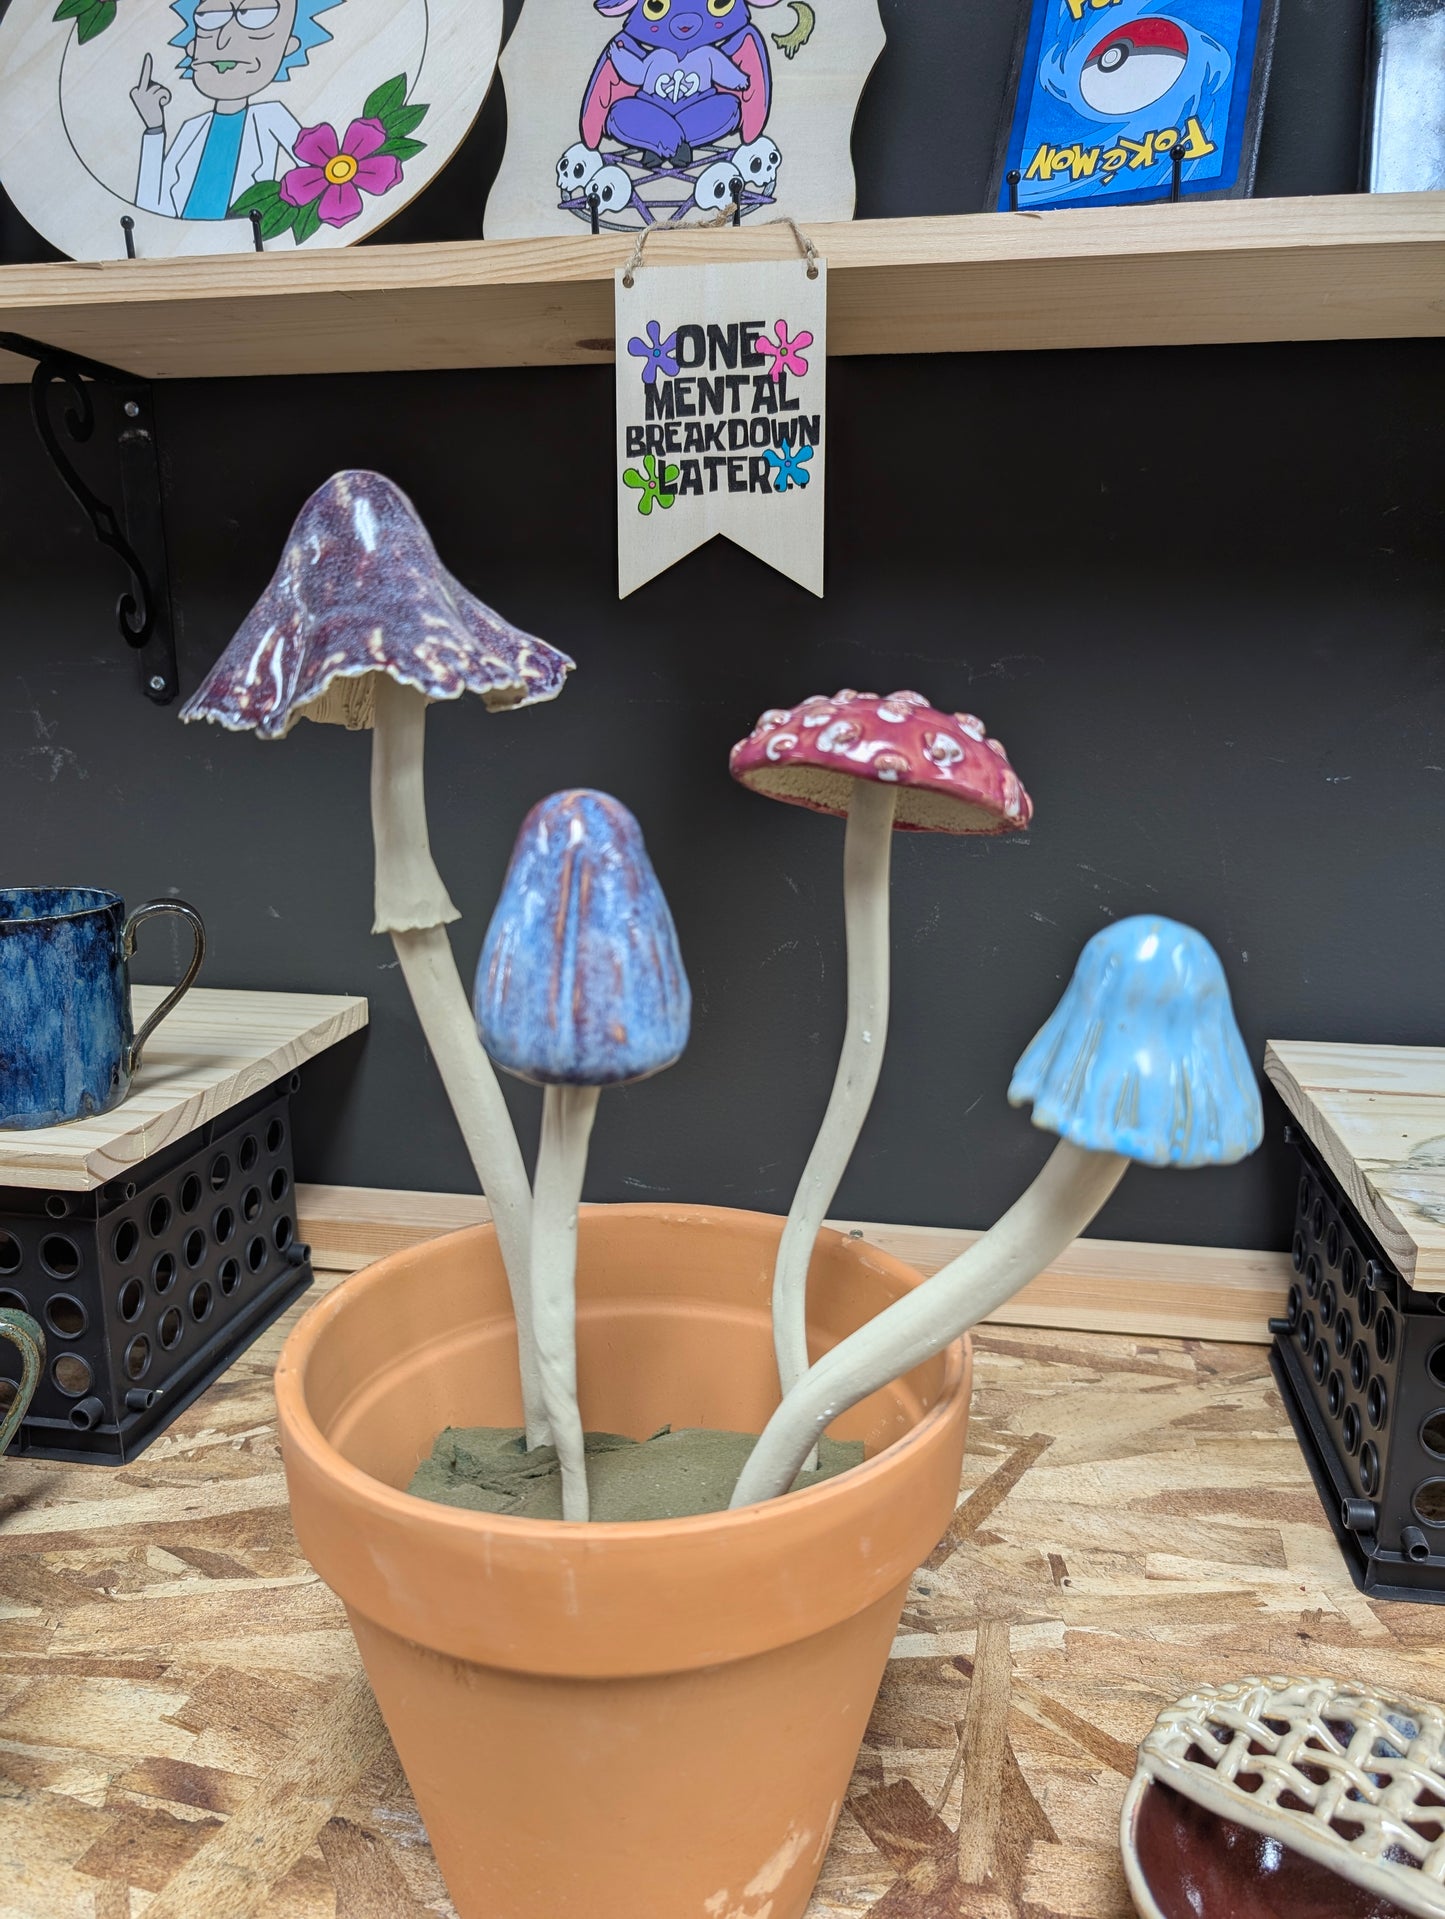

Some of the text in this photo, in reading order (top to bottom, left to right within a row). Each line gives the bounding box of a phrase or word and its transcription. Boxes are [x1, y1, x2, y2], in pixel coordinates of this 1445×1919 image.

[676, 321, 765, 370] ONE
[645, 372, 799, 420] MENTAL
[626, 415, 820, 458] BREAKDOWN
